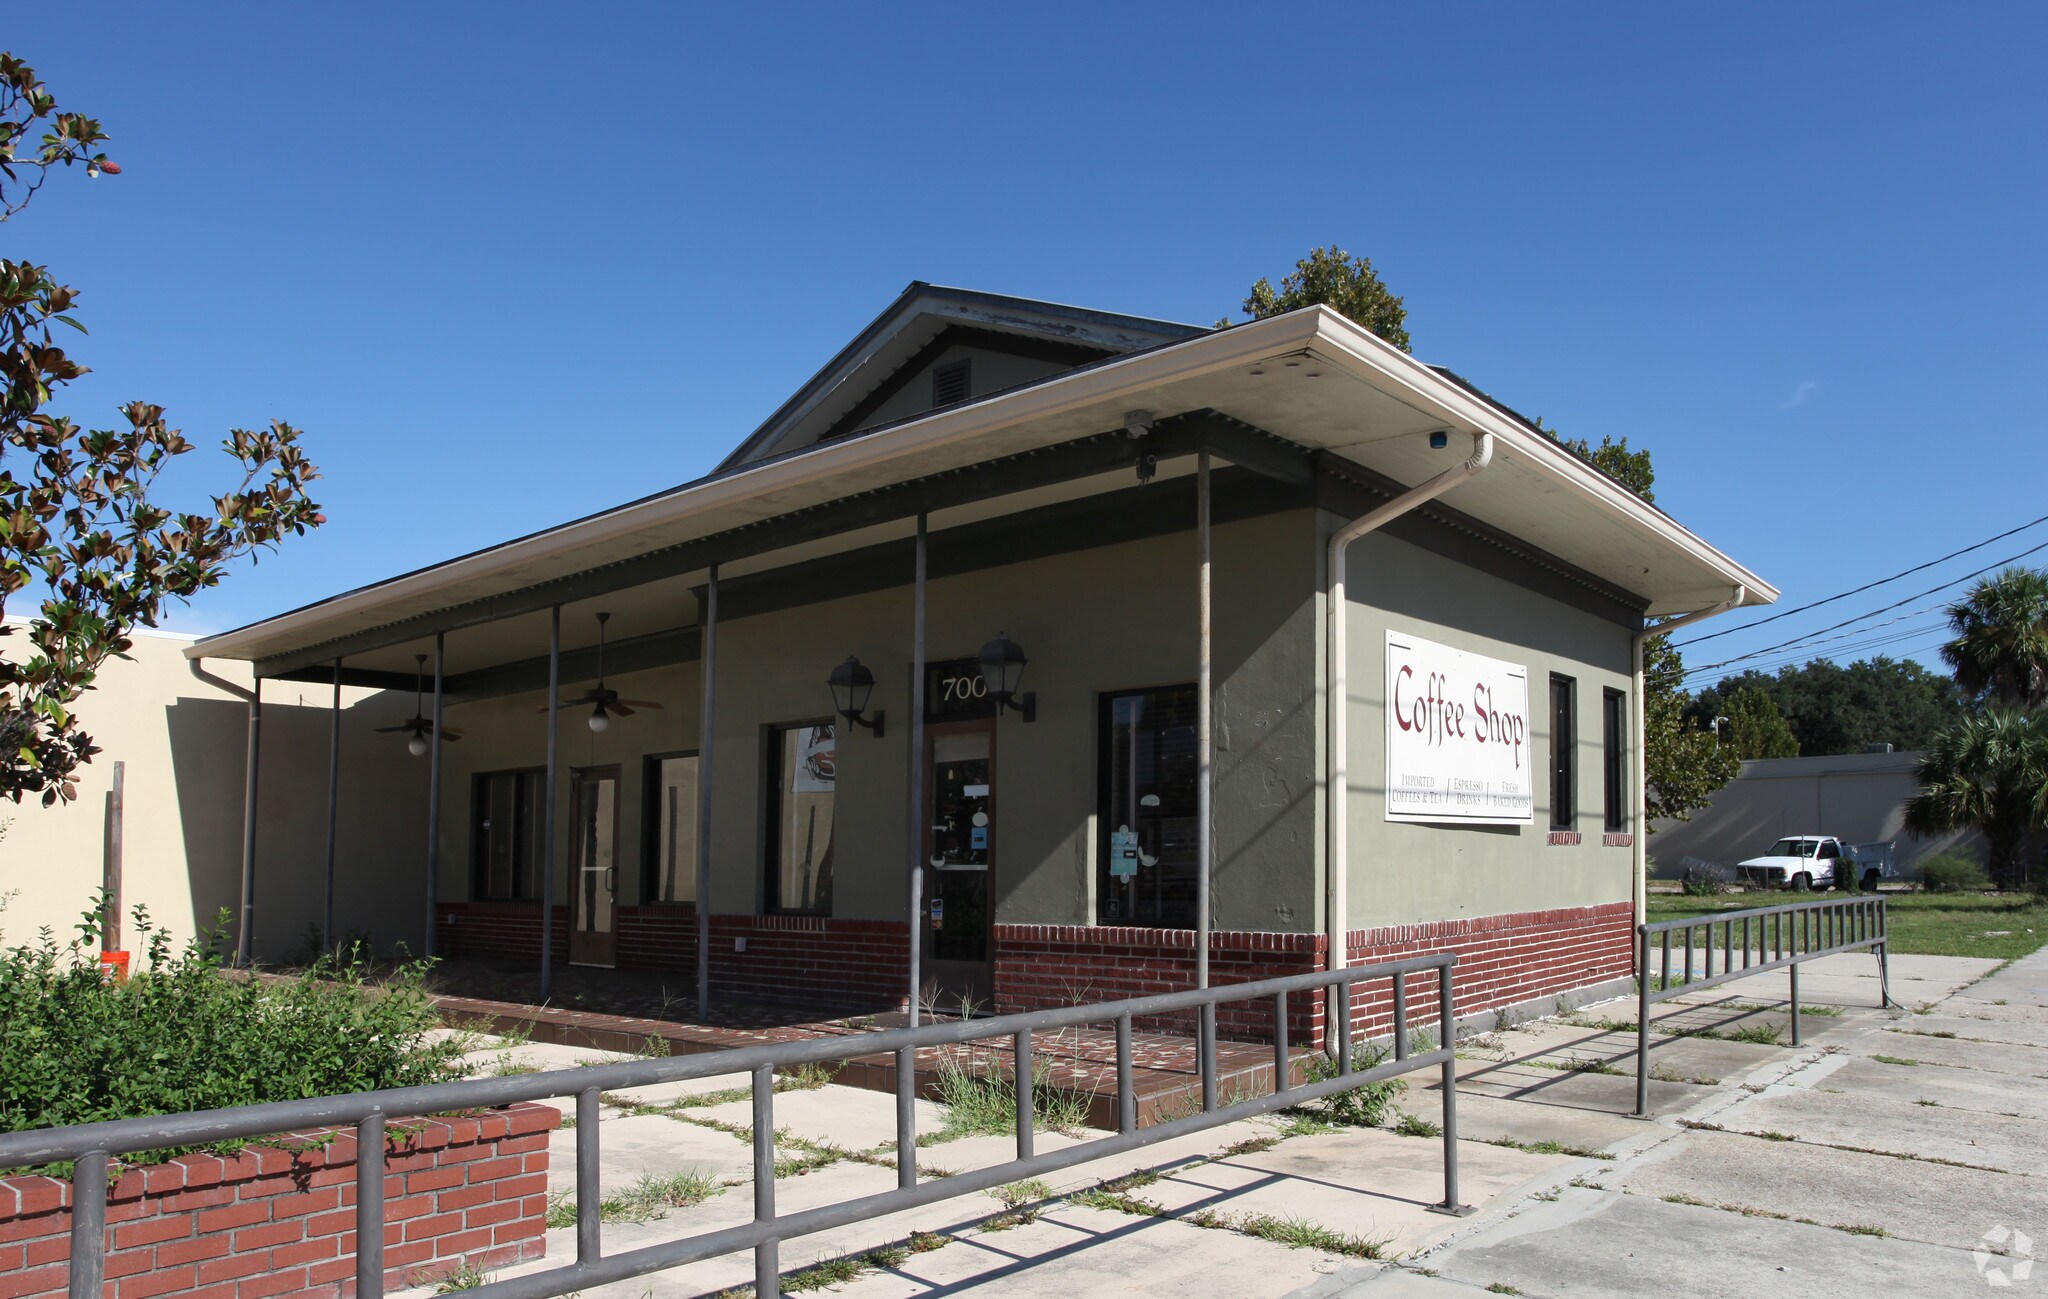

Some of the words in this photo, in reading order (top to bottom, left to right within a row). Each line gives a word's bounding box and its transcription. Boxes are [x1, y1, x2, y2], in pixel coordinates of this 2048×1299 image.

[942, 675, 987, 702] 700
[1395, 665, 1465, 748] Coffee
[1474, 682, 1524, 770] Shop
[1401, 773, 1435, 788] IMPORTED
[1453, 777, 1484, 792] ESPRESSO
[1502, 781, 1519, 794] FRESH
[1392, 788, 1420, 803] COFFEES
[1429, 791, 1443, 804] TEA
[1456, 792, 1481, 806] DRINKS
[1493, 795, 1511, 808] BAKED
